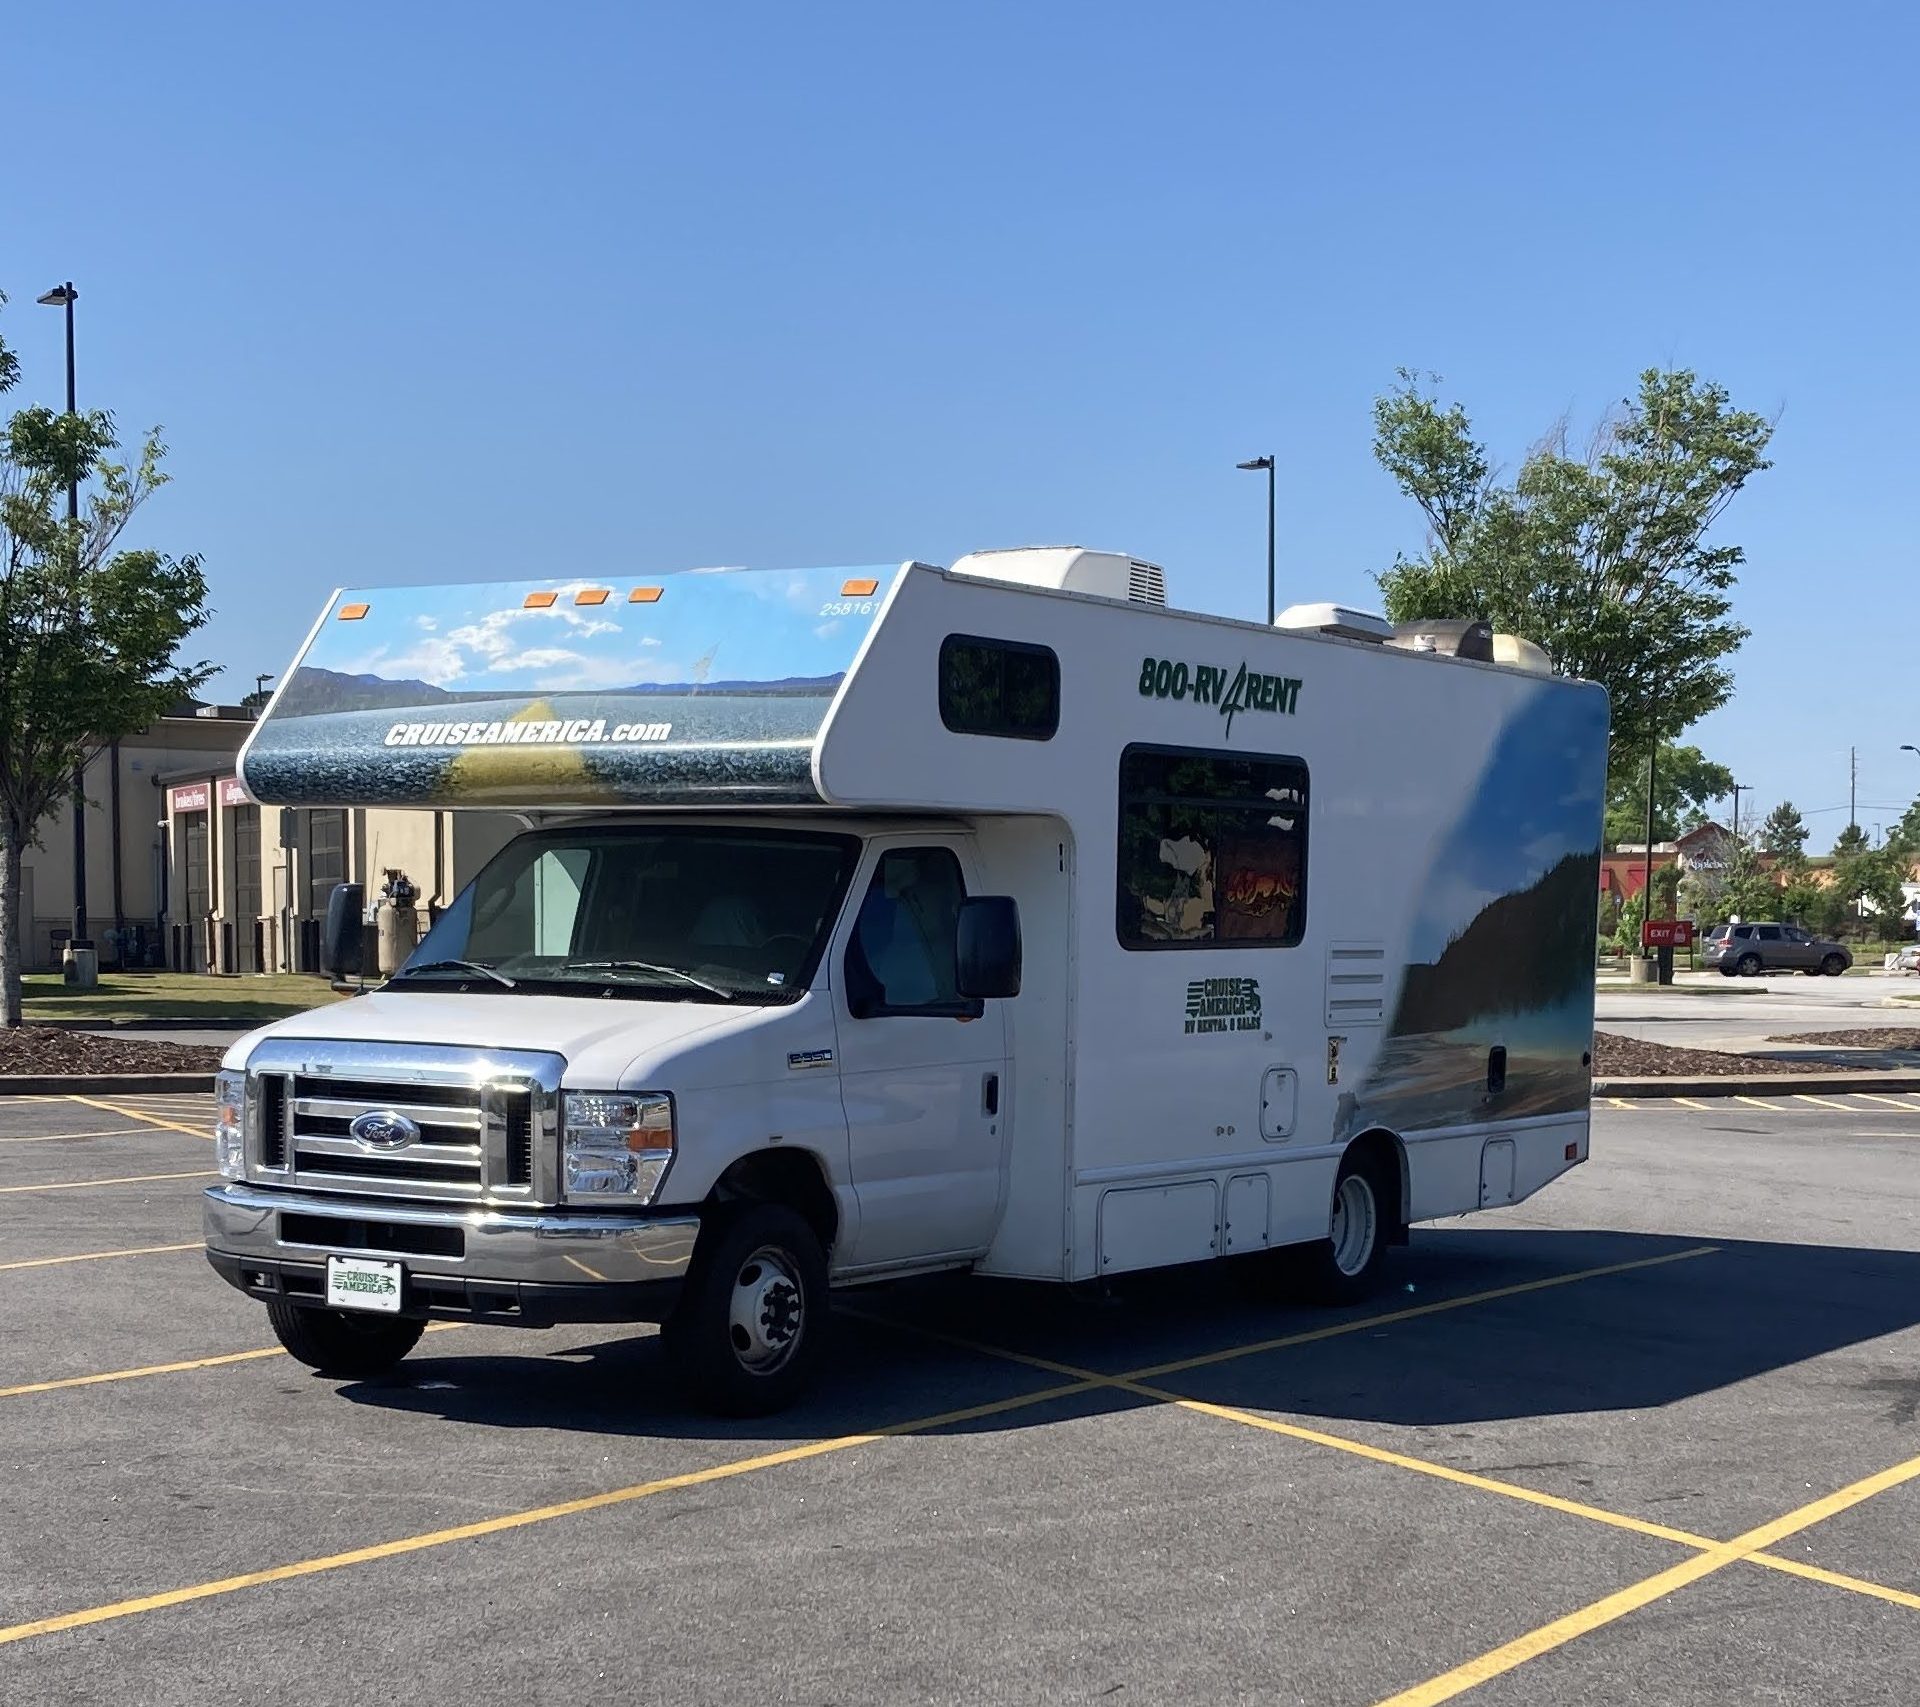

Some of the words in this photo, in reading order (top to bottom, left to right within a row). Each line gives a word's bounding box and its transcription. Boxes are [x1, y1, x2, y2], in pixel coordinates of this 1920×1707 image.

[819, 602, 880, 616] 258161
[384, 719, 672, 745] CRUISEAMERICA.com
[1650, 929, 1670, 938] EXIT
[1204, 978, 1242, 997] CRUISE
[1199, 997, 1245, 1017] AMERICA
[1185, 1020, 1195, 1034] RV
[1197, 1018, 1227, 1033] RENTAL
[1237, 1016, 1261, 1030] SALES
[364, 1122, 395, 1140] Ford
[346, 1270, 380, 1283] CRUISE
[342, 1280, 383, 1295] AMERICA
